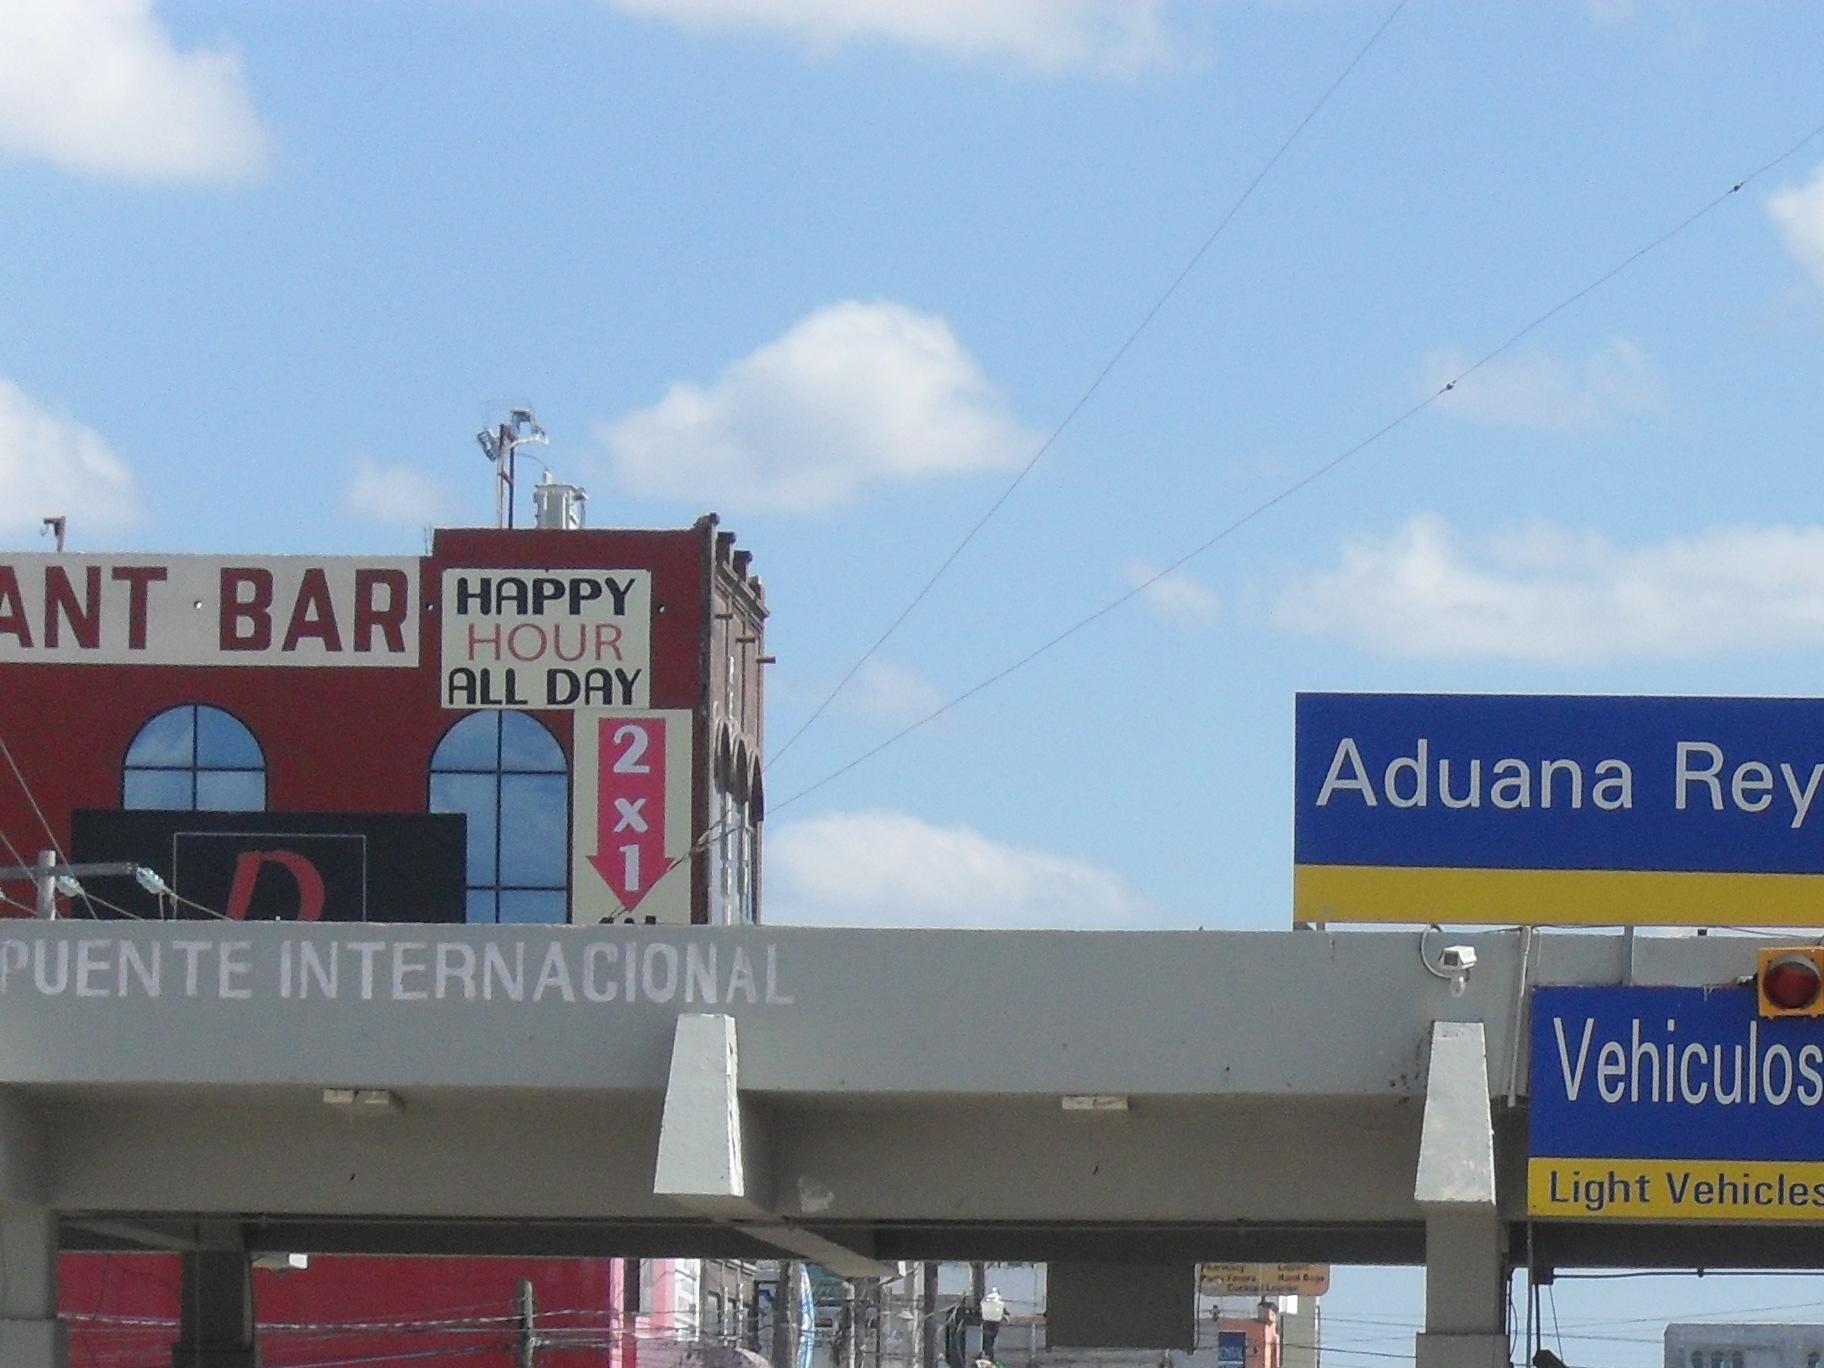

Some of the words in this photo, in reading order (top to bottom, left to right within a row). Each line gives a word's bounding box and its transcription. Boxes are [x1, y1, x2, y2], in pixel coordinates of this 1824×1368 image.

[218, 566, 410, 653] BAR
[455, 576, 637, 617] HAPPY
[467, 623, 624, 661] HOUR
[448, 668, 529, 706] ALL
[546, 668, 643, 706] DAY
[1316, 736, 1634, 811] Aduana
[1, 938, 254, 1000] PUENTE
[279, 940, 799, 1004] INTERNACIONAL
[1553, 1015, 1824, 1108] Vehiculos
[1548, 1170, 1651, 1212] Light
